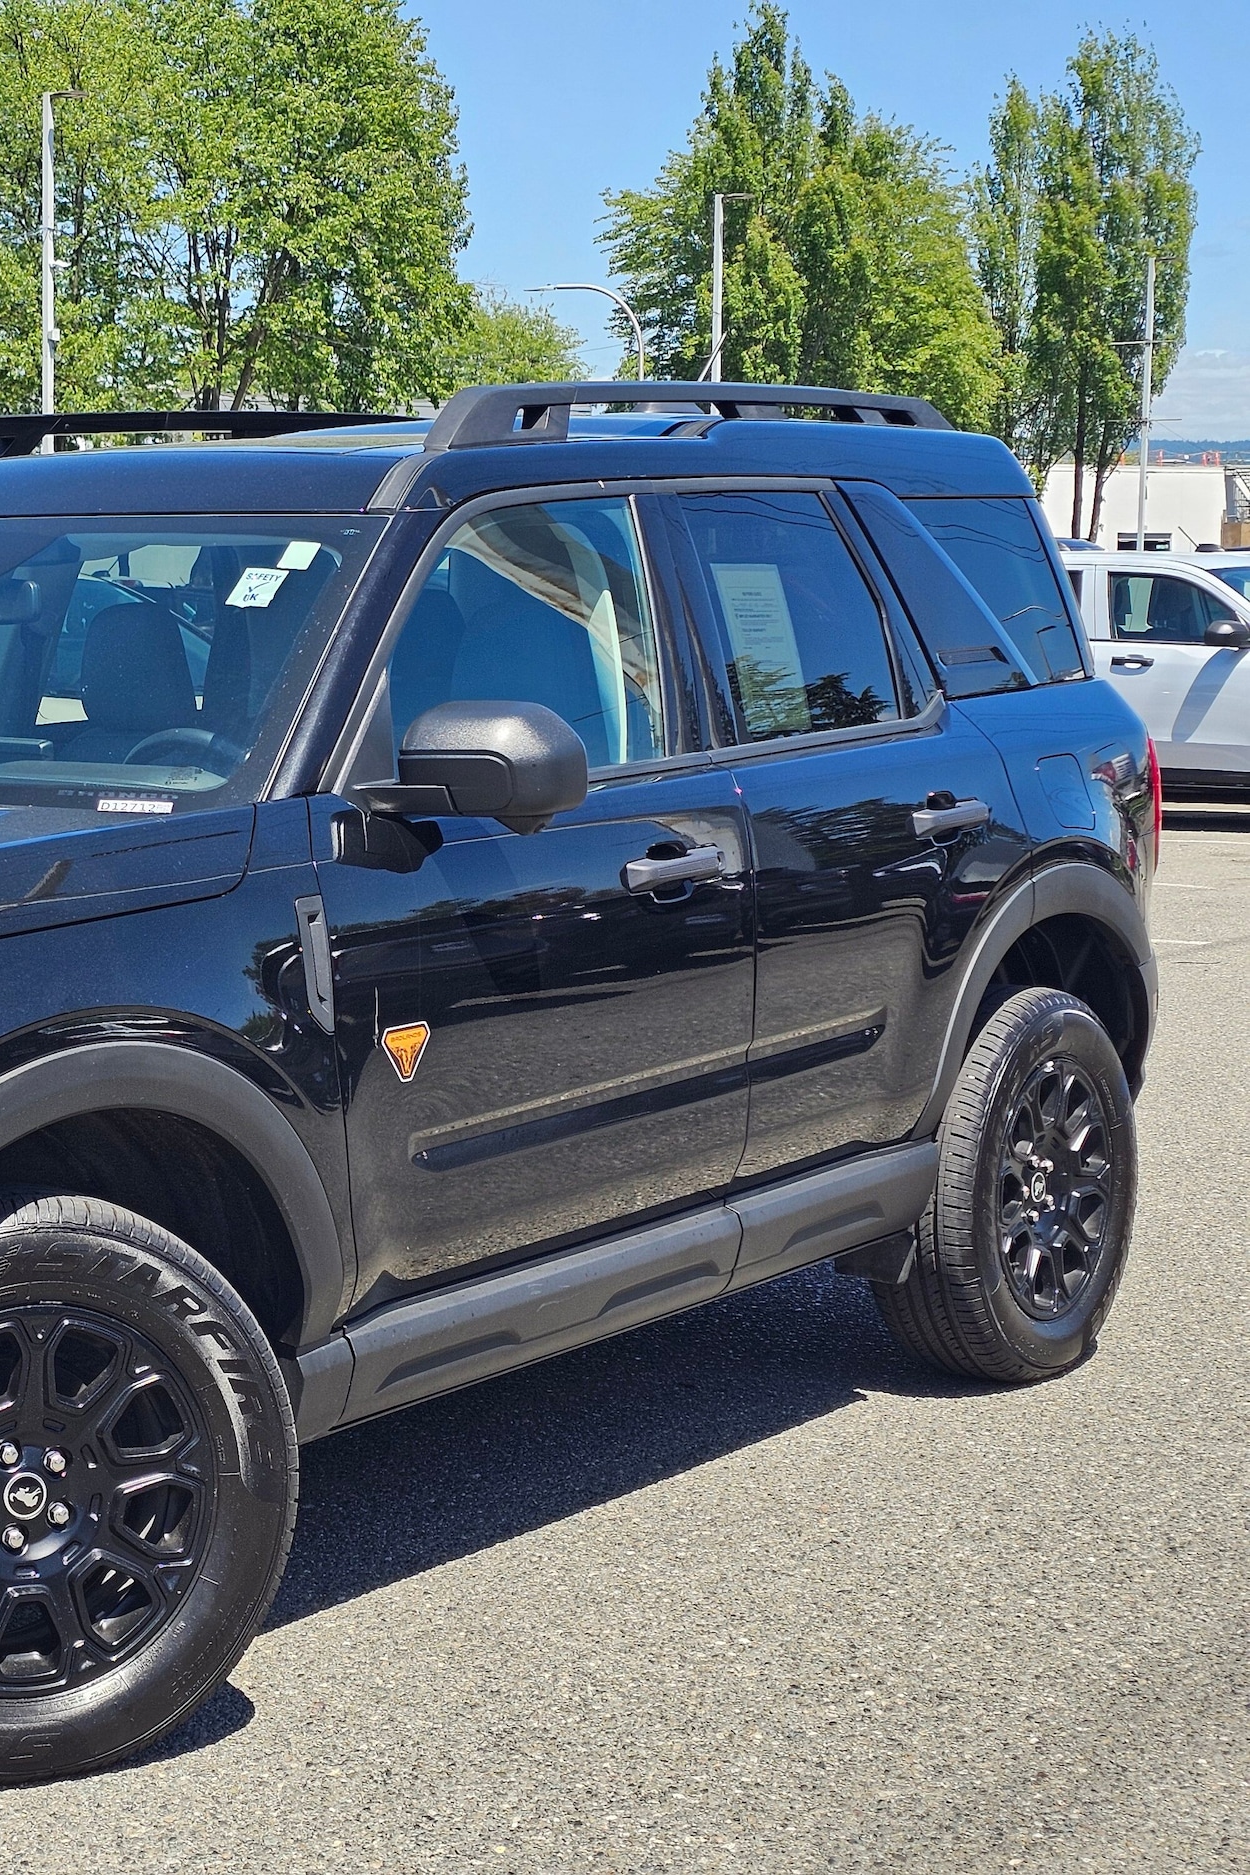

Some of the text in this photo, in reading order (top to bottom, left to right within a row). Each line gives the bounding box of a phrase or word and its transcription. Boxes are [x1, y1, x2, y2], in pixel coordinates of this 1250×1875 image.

[246, 573, 282, 581] SAFETY
[242, 593, 259, 602] OK
[33, 1241, 278, 1474] STARFIRE
